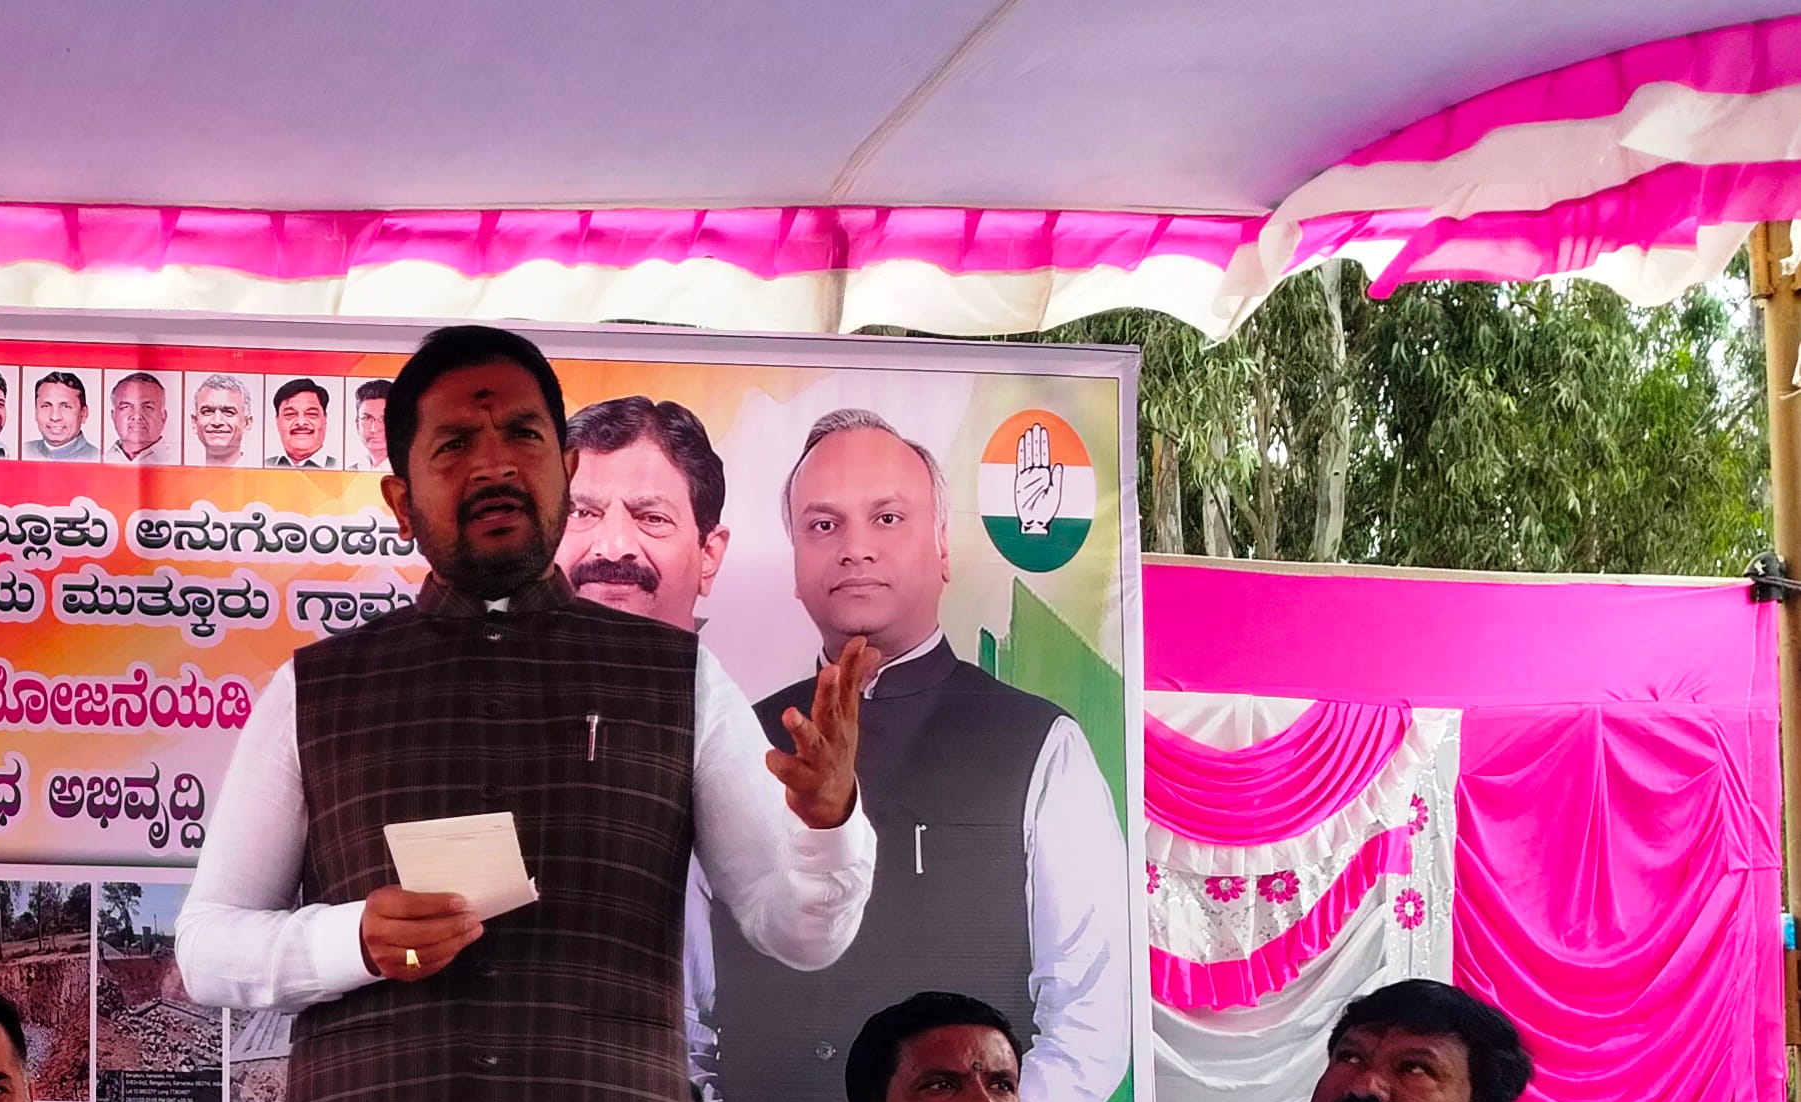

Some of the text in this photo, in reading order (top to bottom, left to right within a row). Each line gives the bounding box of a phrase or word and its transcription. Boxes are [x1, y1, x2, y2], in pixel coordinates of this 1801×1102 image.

[135, 509, 422, 557] ಅನುಗೊಂಡನ
[62, 573, 270, 638] ಮುತ್ಕೂರು
[296, 581, 420, 635] ಗ್ರಾಮ
